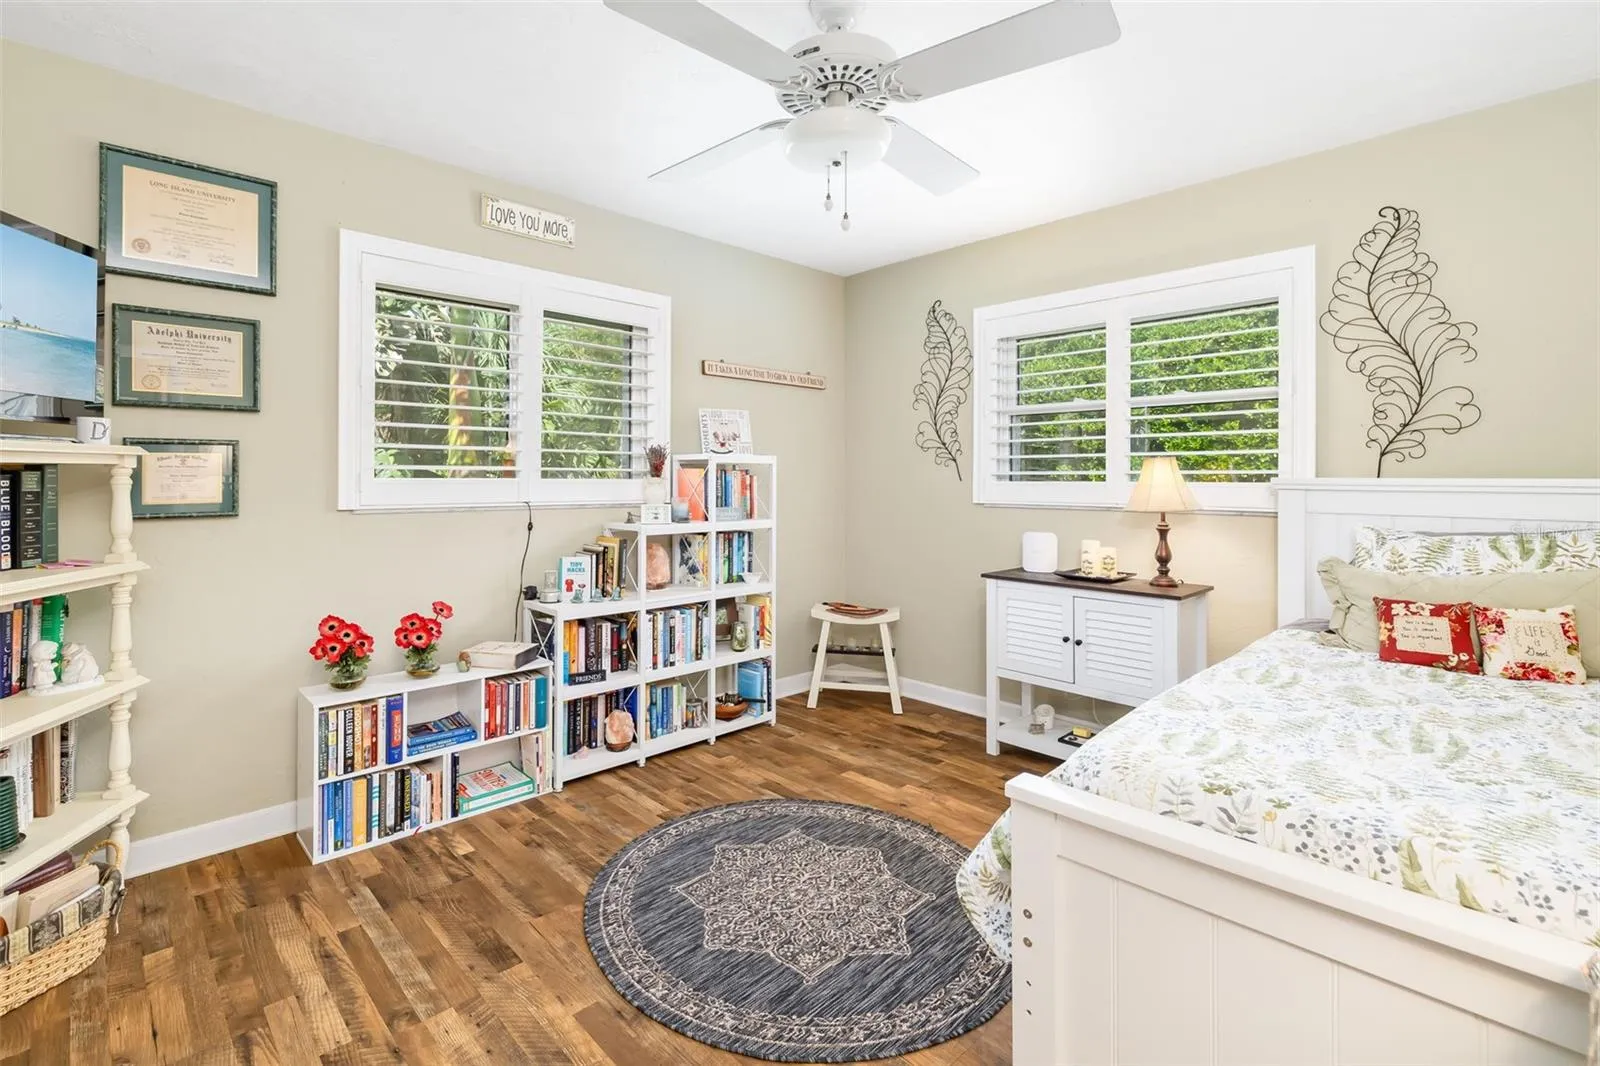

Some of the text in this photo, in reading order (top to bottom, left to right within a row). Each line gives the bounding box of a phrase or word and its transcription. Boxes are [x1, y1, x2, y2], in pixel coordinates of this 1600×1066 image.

[149, 180, 236, 203] LONG ISLAND UNIVERSITY
[519, 212, 540, 231] YOU
[147, 326, 232, 344] Adelphi University
[715, 364, 733, 374] TAKES
[738, 368, 752, 376] LONG
[753, 368, 765, 378] TIME
[774, 372, 787, 381] GROW
[807, 376, 824, 386] FRIEND
[90, 422, 108, 440] D
[701, 414, 710, 454] MOMENTS
[0, 480, 10, 511] BLUE
[1523, 626, 1545, 638] LIFE
[1525, 645, 1551, 657] Good
[575, 673, 602, 682] FRIENDS
